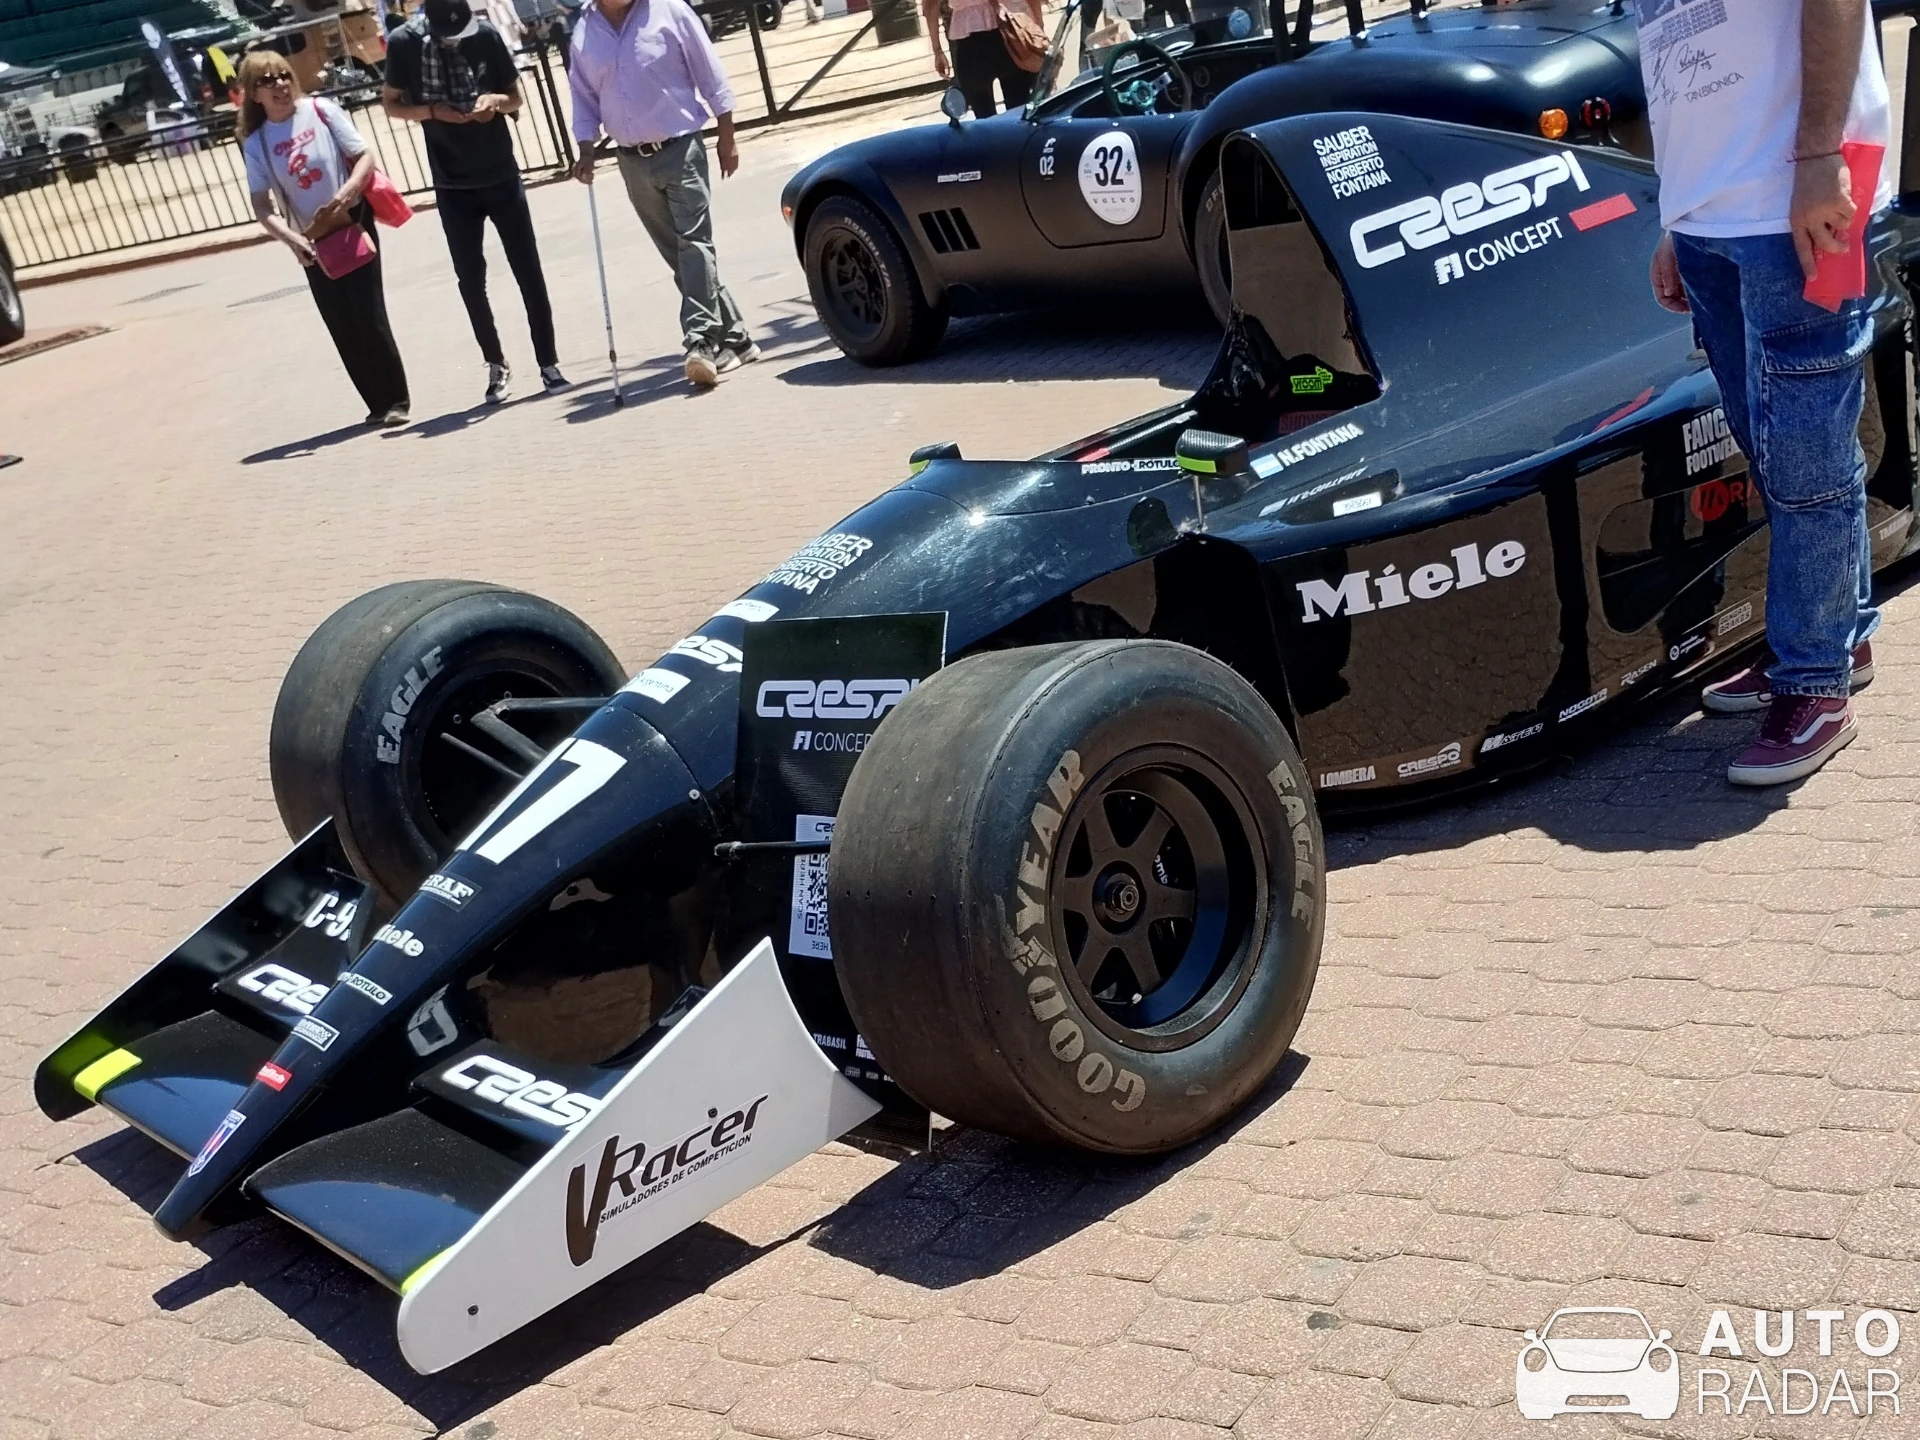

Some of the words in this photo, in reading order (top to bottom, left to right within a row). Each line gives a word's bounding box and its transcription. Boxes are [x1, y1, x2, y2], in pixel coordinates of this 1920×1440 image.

[1313, 125, 1373, 156] SAUBER
[1320, 141, 1378, 168] INSPIRATION
[1039, 156, 1055, 176] 02
[1094, 146, 1124, 187] 32
[1326, 155, 1384, 184] NORBERTO
[1332, 169, 1392, 200] FONTANA
[1465, 217, 1563, 272] CONCEPT
[1277, 423, 1364, 467] N.FONTANA
[1682, 408, 1731, 454] FANG
[1081, 460, 1131, 475] PRONTO
[1686, 435, 1742, 476] FOOTWE
[802, 533, 874, 557] UBER
[1296, 541, 1526, 623] Miele
[1719, 611, 1750, 634] BRAKES
[376, 646, 444, 764] EAGLE
[814, 732, 874, 752] CONCEP
[1320, 765, 1376, 788] LOMBERA
[1397, 751, 1460, 774] CRESPO
[1267, 760, 1315, 932] EAGLE
[373, 924, 424, 957] iele
[1014, 749, 1147, 1112] GOODYEAR
[441, 1055, 602, 1131] CRES
[600, 1178, 669, 1224] SIMULADORES
[671, 1170, 685, 1184] DE
[687, 1132, 752, 1175] COMPETICION
